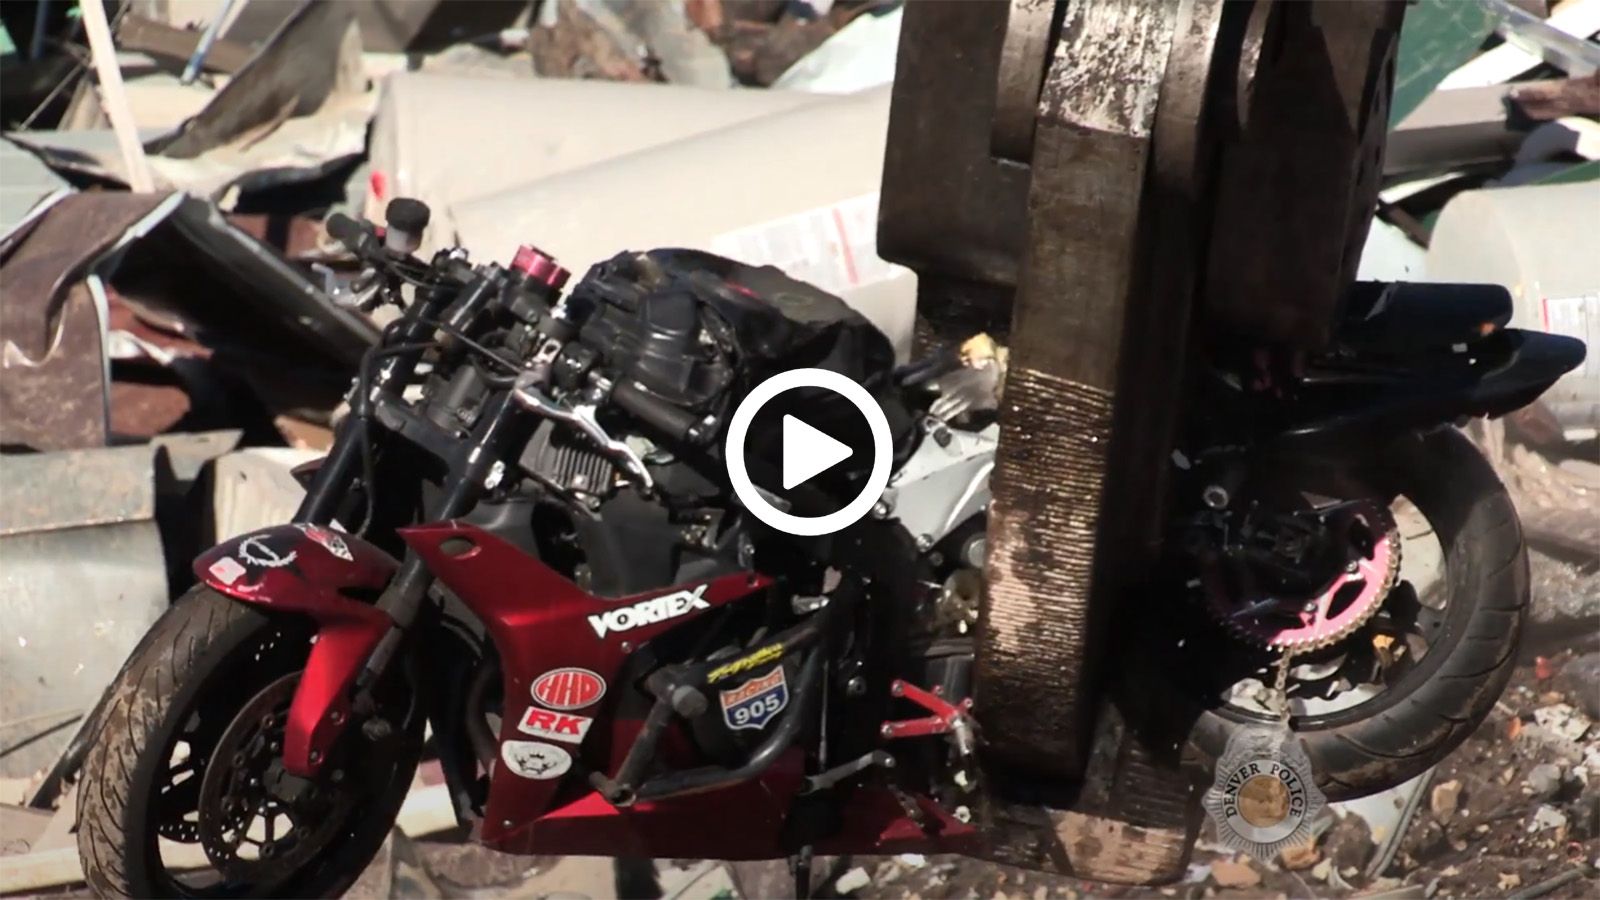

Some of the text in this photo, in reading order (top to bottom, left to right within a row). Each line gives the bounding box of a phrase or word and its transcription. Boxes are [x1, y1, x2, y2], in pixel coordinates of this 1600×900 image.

[588, 583, 711, 639] VORTEX
[526, 709, 586, 735] RK
[735, 694, 780, 724] 905
